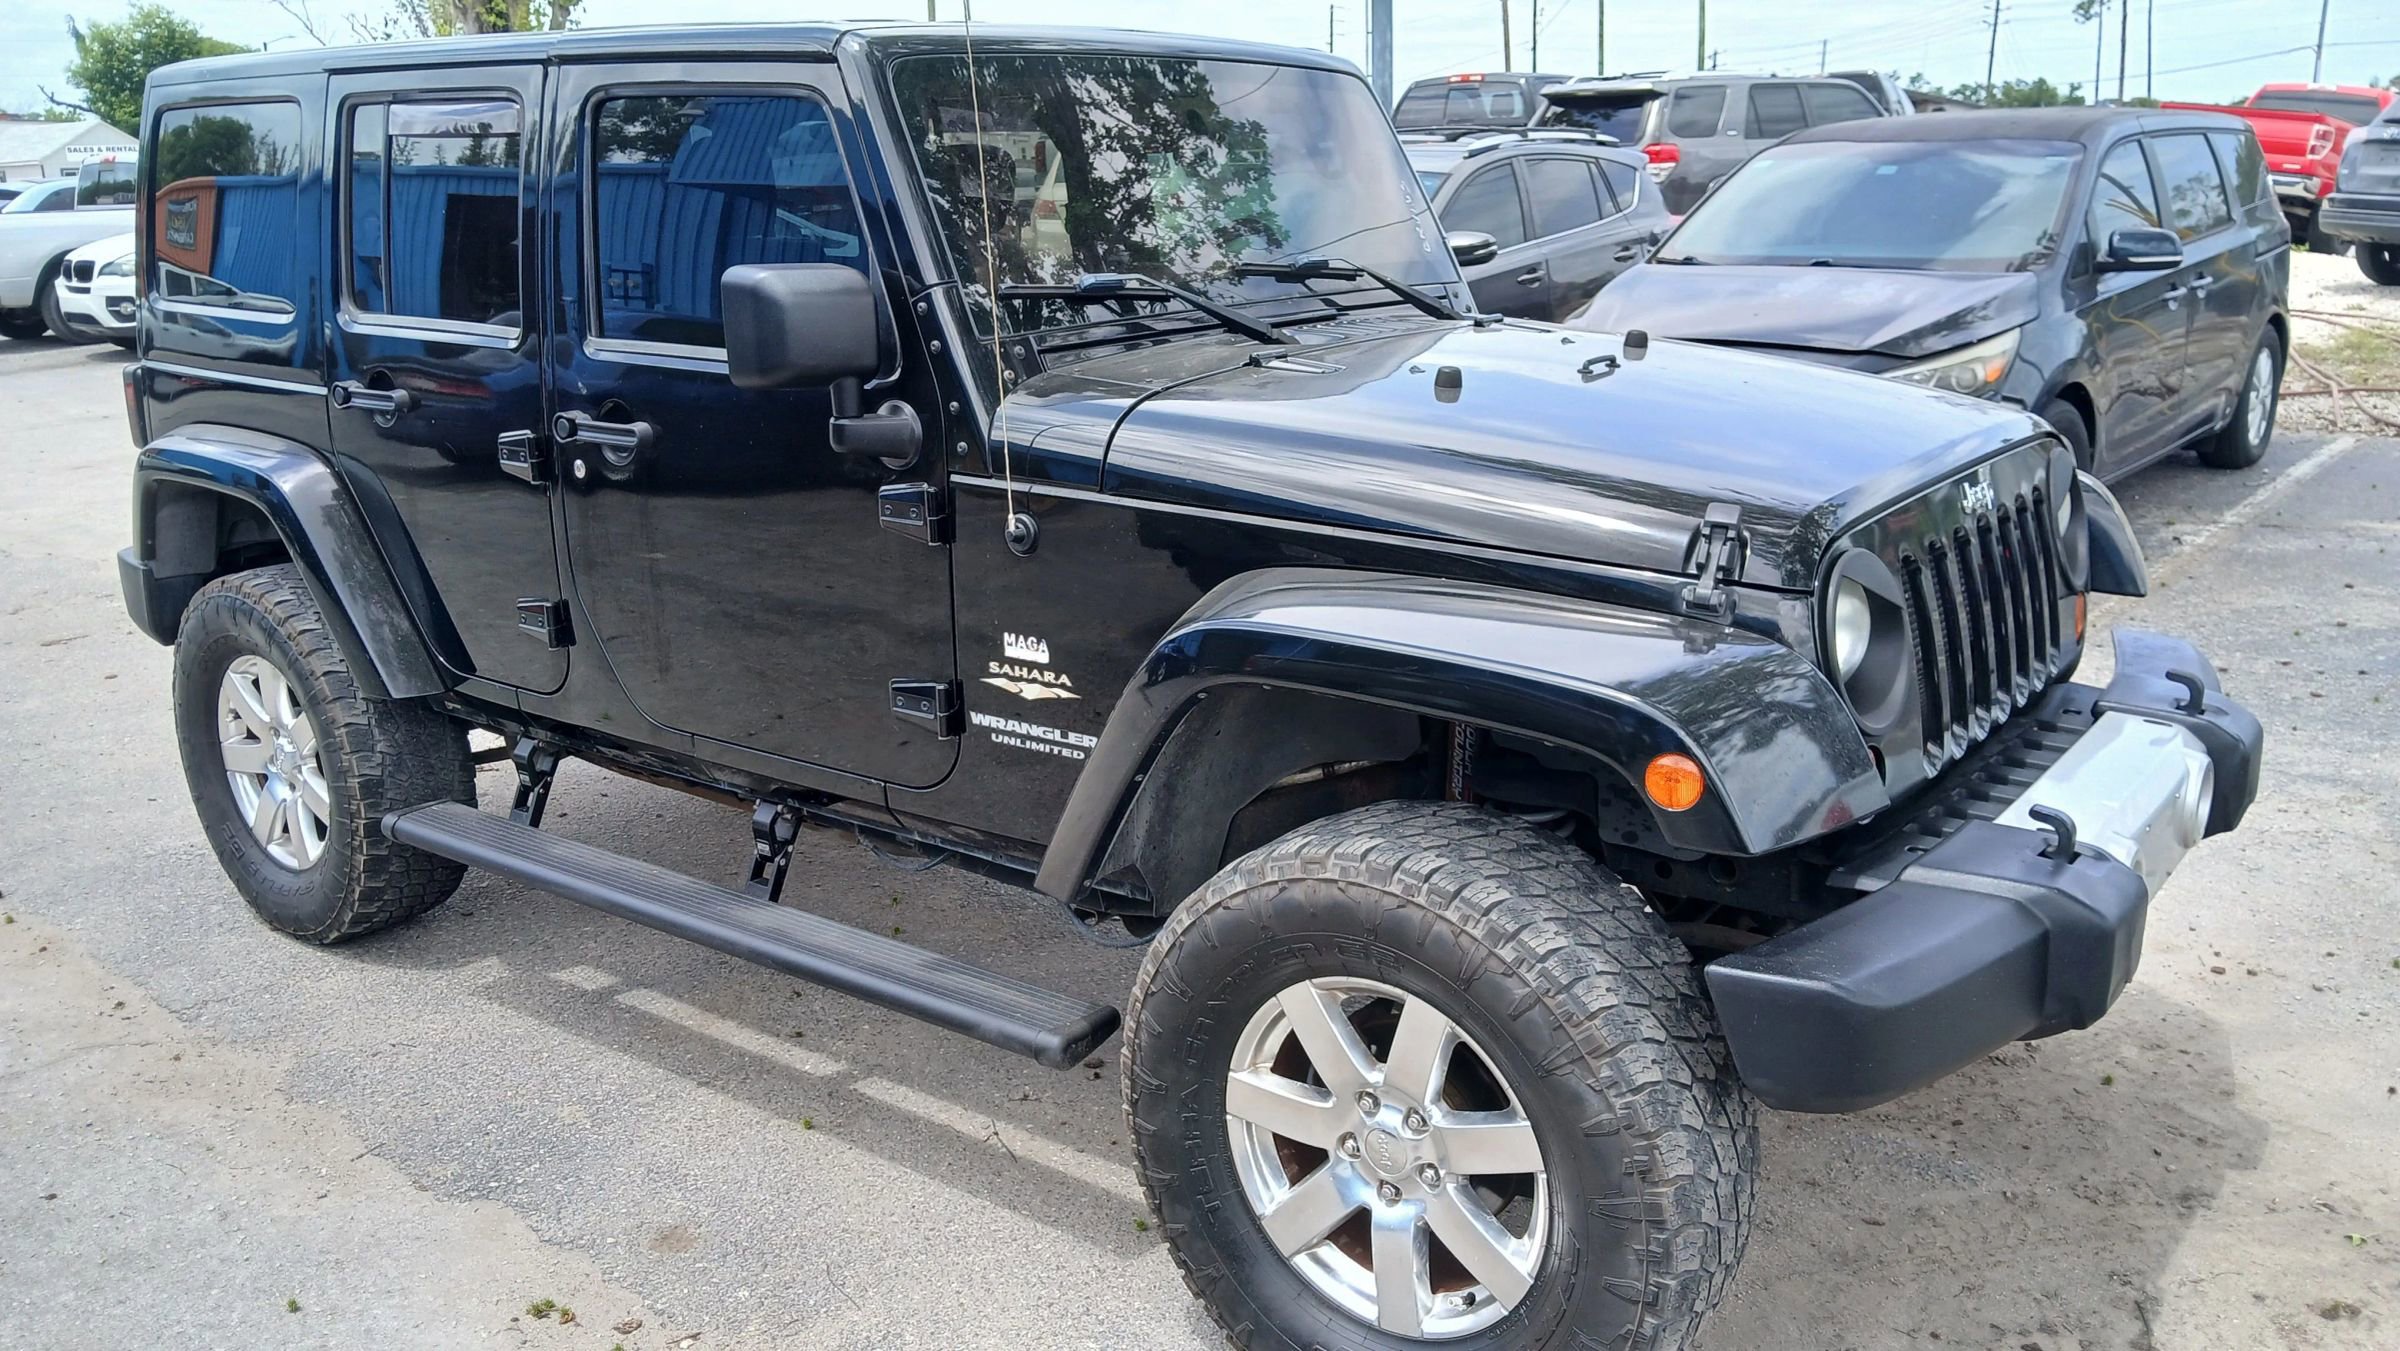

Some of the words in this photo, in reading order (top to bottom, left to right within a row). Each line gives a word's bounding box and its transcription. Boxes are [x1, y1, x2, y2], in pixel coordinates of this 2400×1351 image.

[1003, 631, 1049, 656] MAGA
[988, 661, 1073, 687] SAHARA
[969, 710, 1098, 748] WRANGLER
[991, 732, 1085, 759] UNLIMITED
